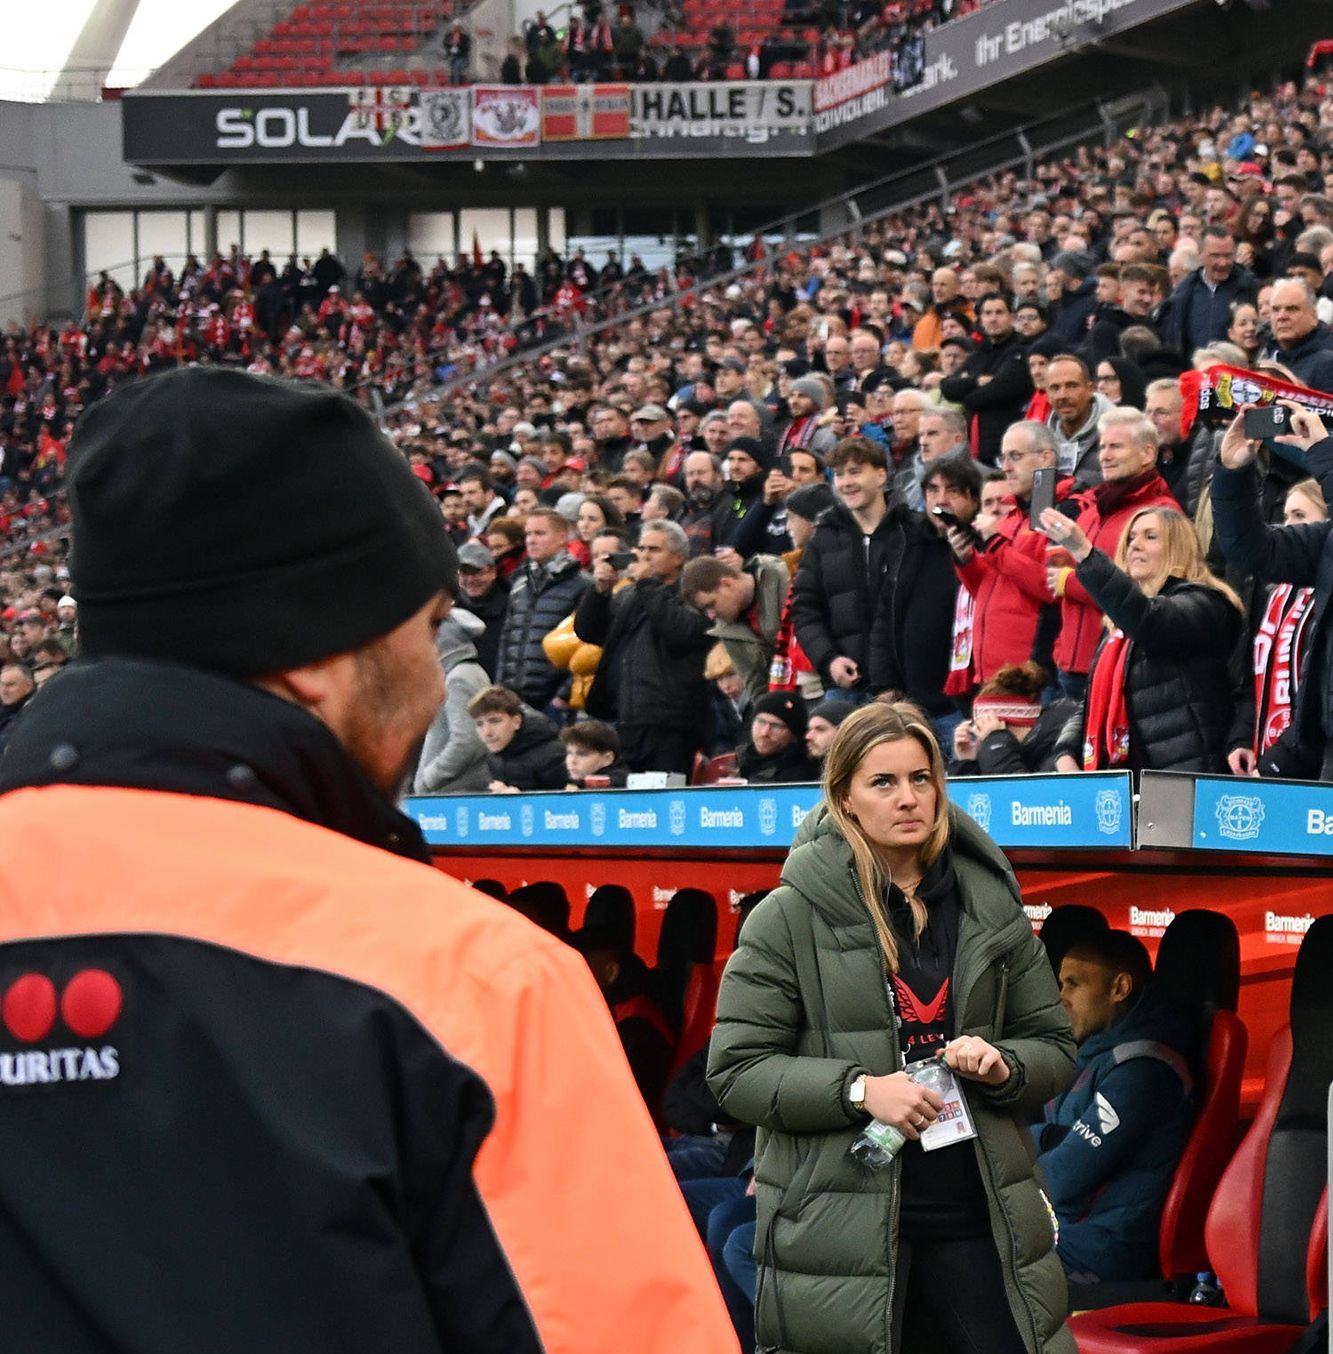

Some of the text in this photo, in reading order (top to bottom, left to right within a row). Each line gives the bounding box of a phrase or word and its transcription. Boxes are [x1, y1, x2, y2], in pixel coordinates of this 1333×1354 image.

[642, 87, 746, 120] HALLE
[619, 808, 657, 828] Barmenia
[701, 806, 743, 828] Barmenia
[1011, 800, 1072, 826] Barmenia
[0, 1045, 120, 1086] URITAS
[1072, 1119, 1102, 1148] trive
